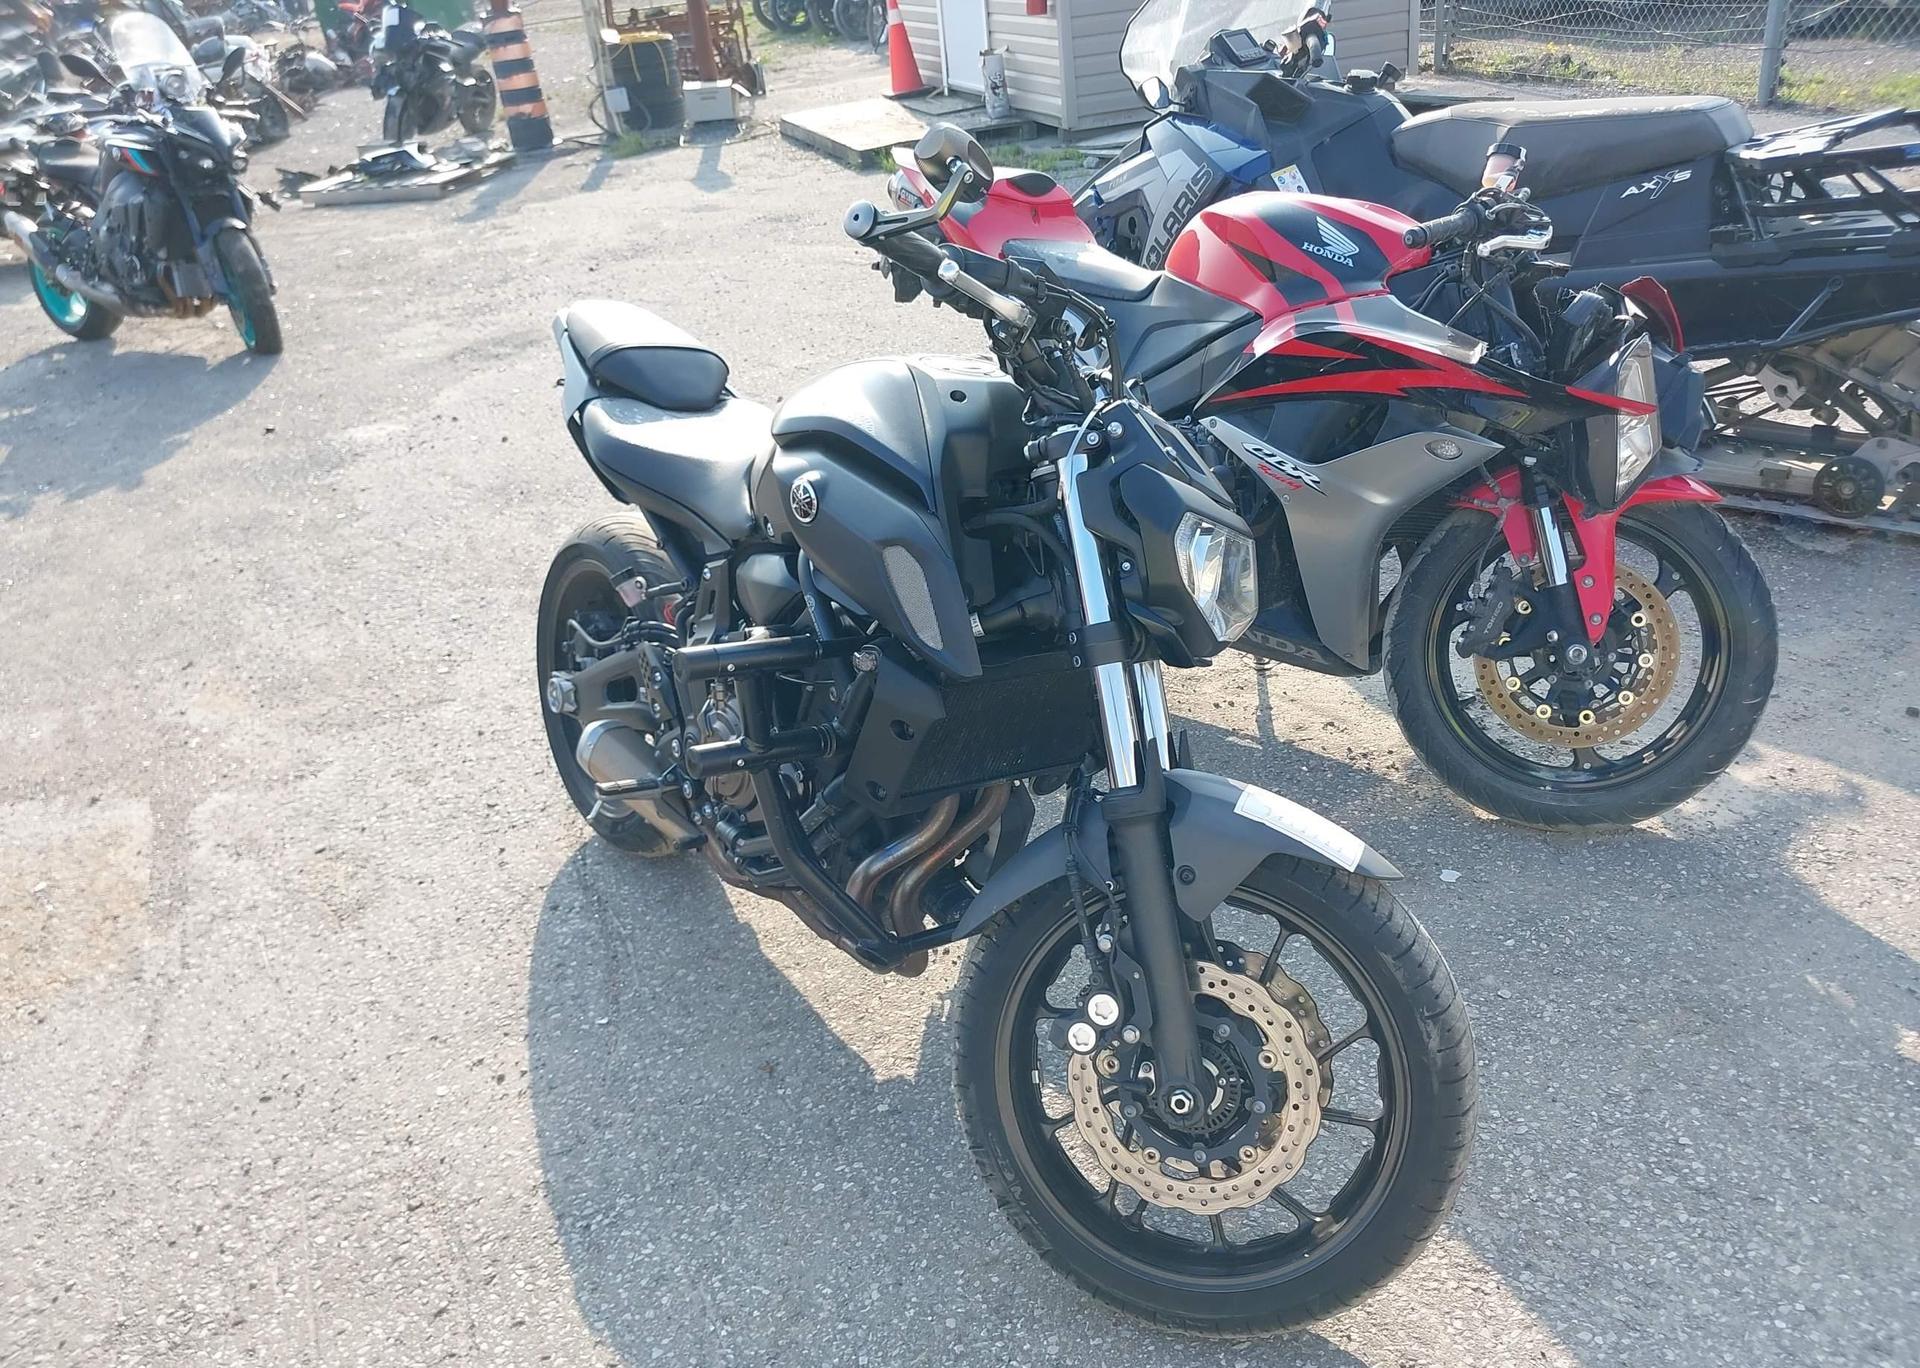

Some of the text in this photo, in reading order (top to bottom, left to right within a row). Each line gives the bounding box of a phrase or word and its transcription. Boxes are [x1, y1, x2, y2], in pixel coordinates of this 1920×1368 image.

[1620, 169, 1692, 199] AXYS
[1143, 161, 1214, 271] OLARIS
[1301, 241, 1354, 267] HONDA
[1241, 442, 1328, 496] CBR
[1244, 629, 1329, 665] NDA
